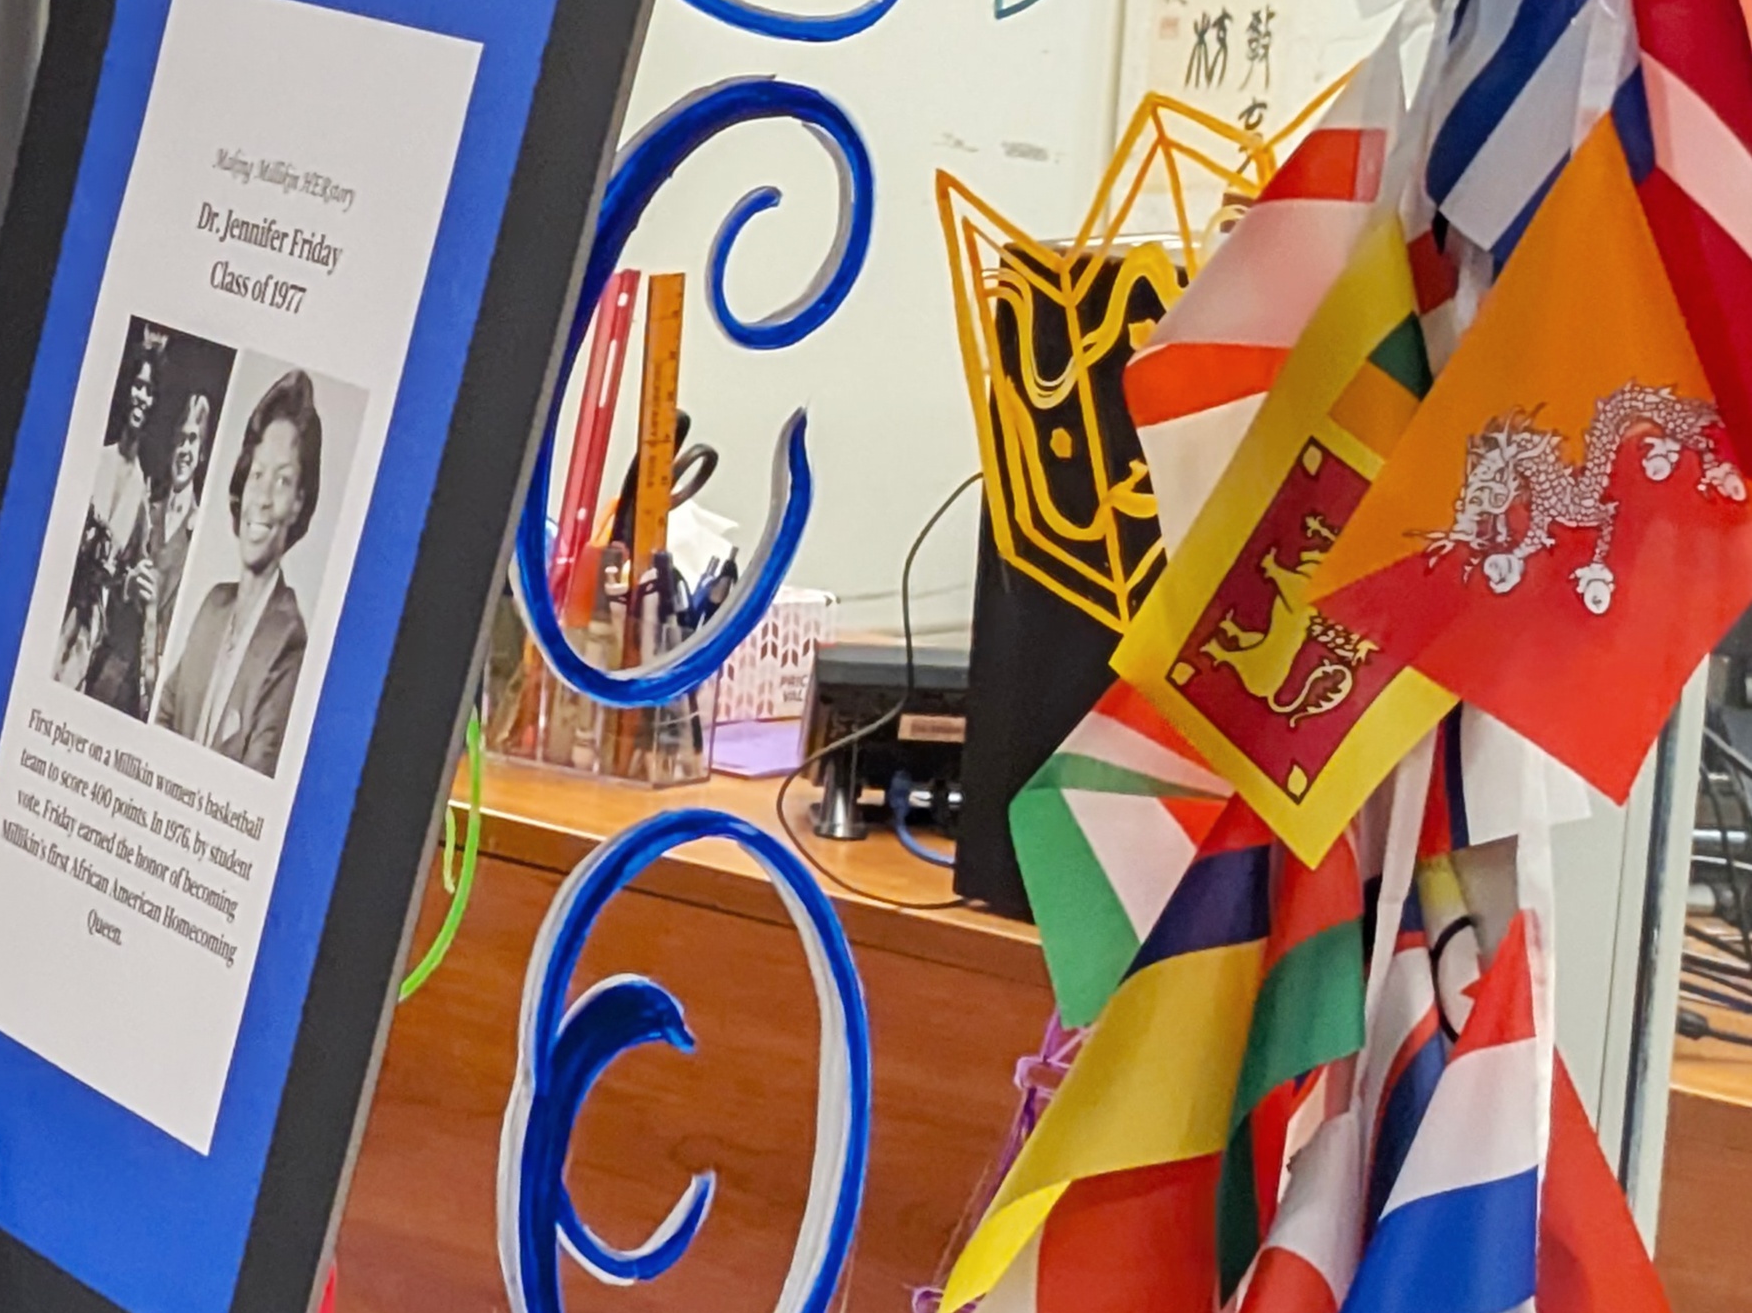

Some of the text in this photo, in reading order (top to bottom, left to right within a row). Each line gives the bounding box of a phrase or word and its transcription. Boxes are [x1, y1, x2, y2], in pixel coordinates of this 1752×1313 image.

[197, 202, 343, 276] Dr. Jennifer Friday
[210, 260, 307, 315] Class of 1977
[20, 749, 252, 881] team to score 400 points. In 1976, by student
[28, 708, 264, 842] First player on a Millikin women's basketball
[2, 818, 238, 969] Millikin's first African American Homecoming
[18, 789, 239, 924] vote, Friday earned the honor of becoming
[87, 908, 123, 946] Queen.
